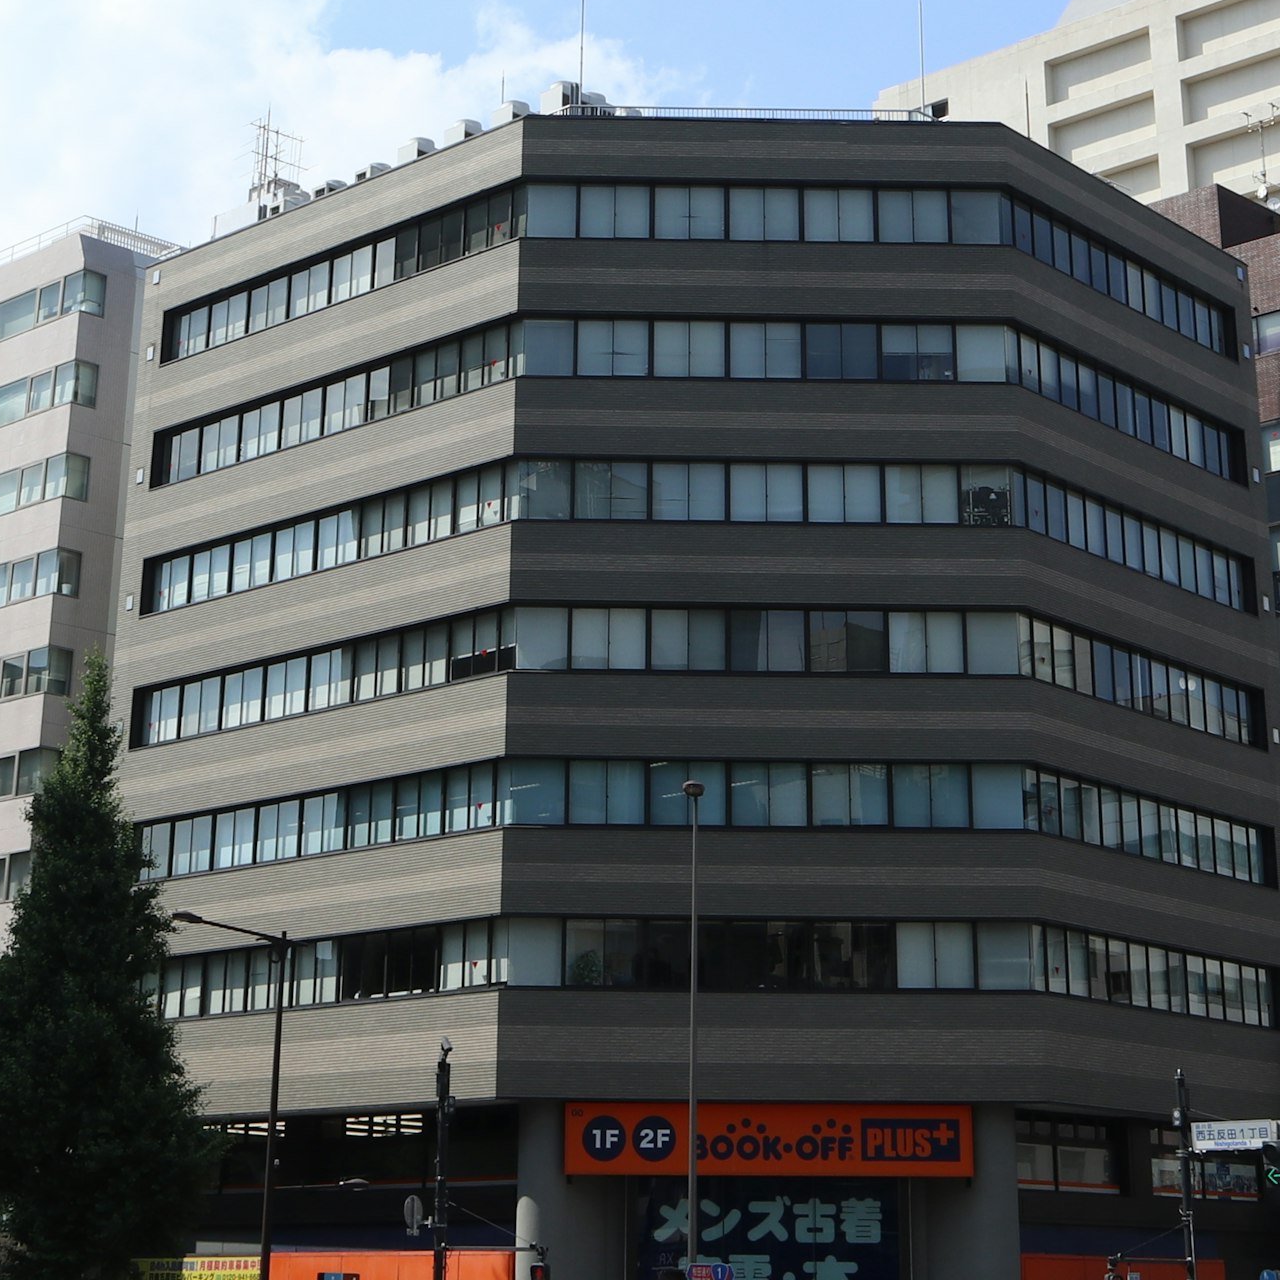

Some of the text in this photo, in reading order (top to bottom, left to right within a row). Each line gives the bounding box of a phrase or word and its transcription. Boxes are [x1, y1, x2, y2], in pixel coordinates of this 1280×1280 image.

[592, 1128, 619, 1149] 1F
[638, 1128, 670, 1149] 2F
[1196, 1128, 1268, 1141] 西五反田1丁目
[654, 1196, 883, 1244] メンズ古着
[716, 1267, 722, 1279] 1
